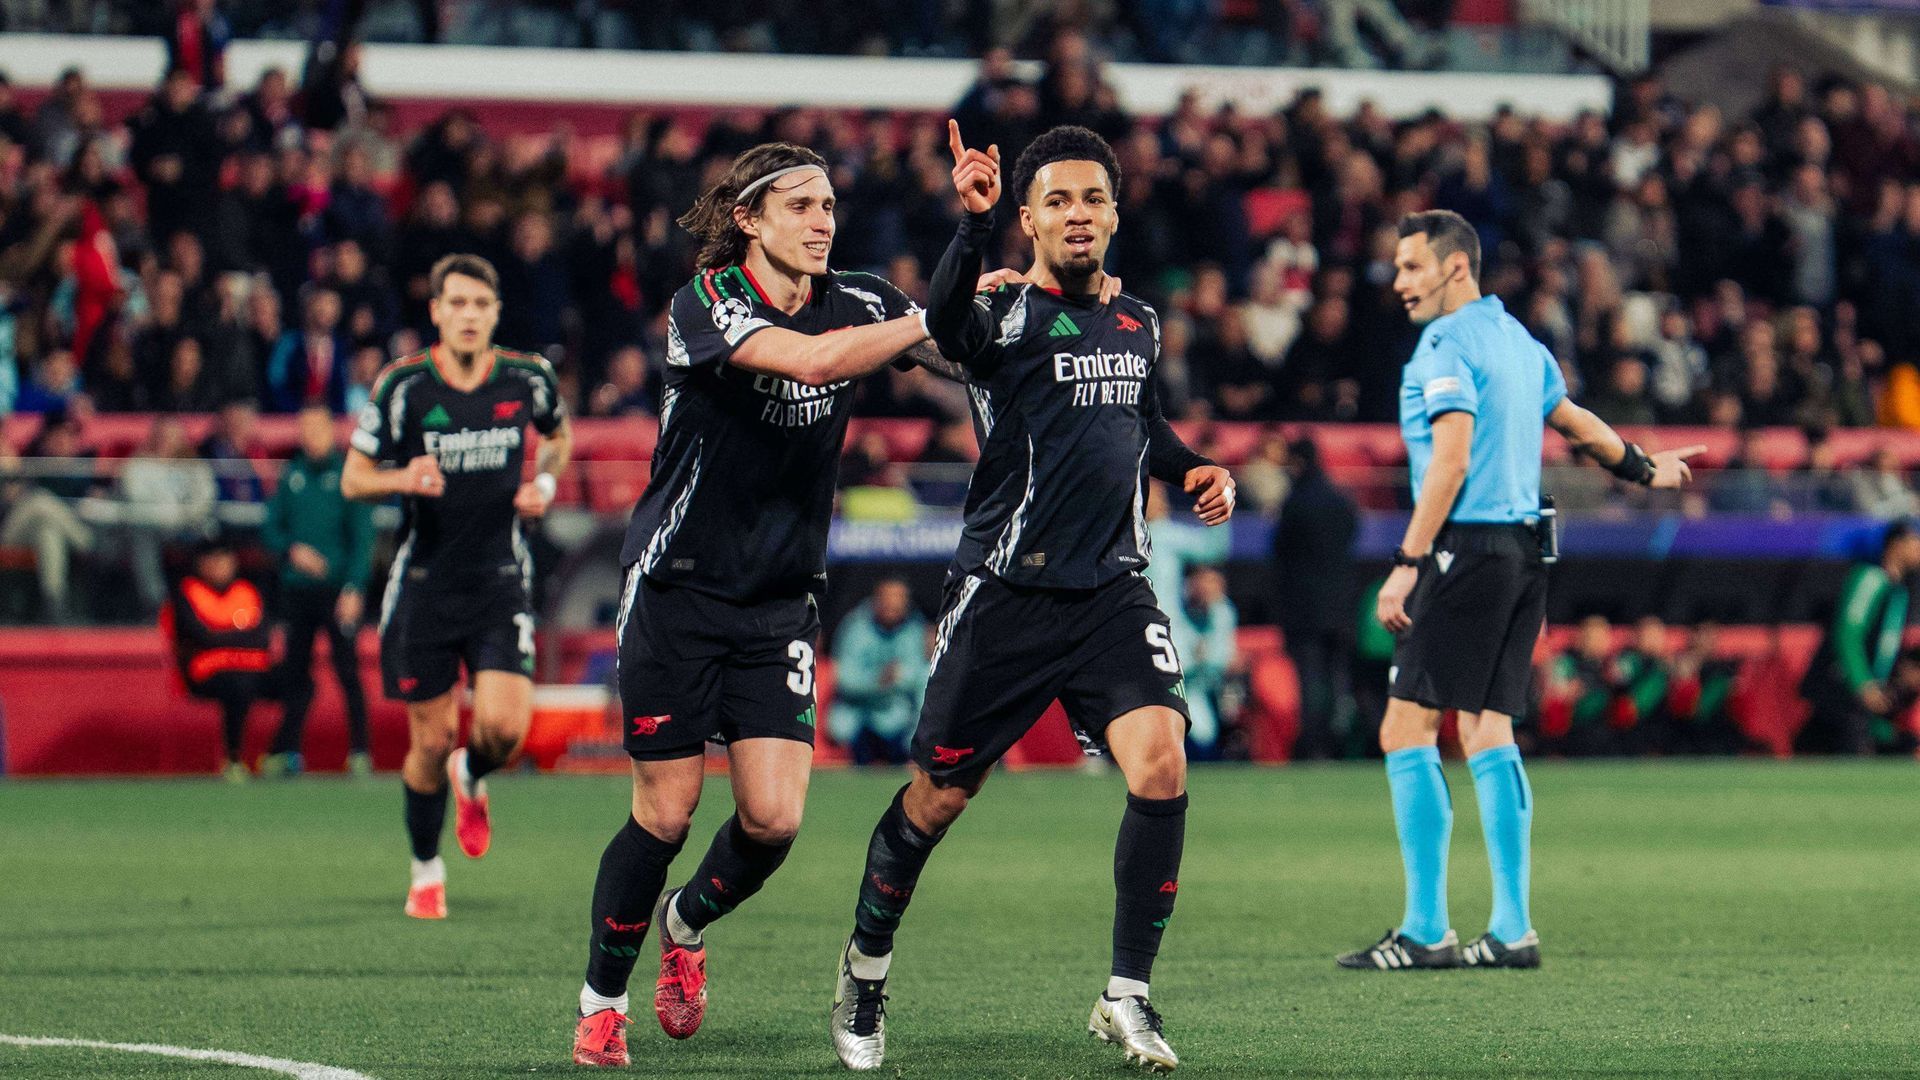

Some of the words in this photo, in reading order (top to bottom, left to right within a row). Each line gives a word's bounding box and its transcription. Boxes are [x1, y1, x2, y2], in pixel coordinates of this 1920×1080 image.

[1053, 347, 1147, 381] Emirates
[753, 373, 850, 400] Emira
[1072, 382, 1098, 406] FLY
[1101, 380, 1141, 405] BETTER
[786, 395, 835, 427] BETTER
[422, 426, 520, 455] Emirates
[1144, 622, 1184, 680] 5
[786, 639, 817, 703] 3
[604, 916, 649, 932] AFC
